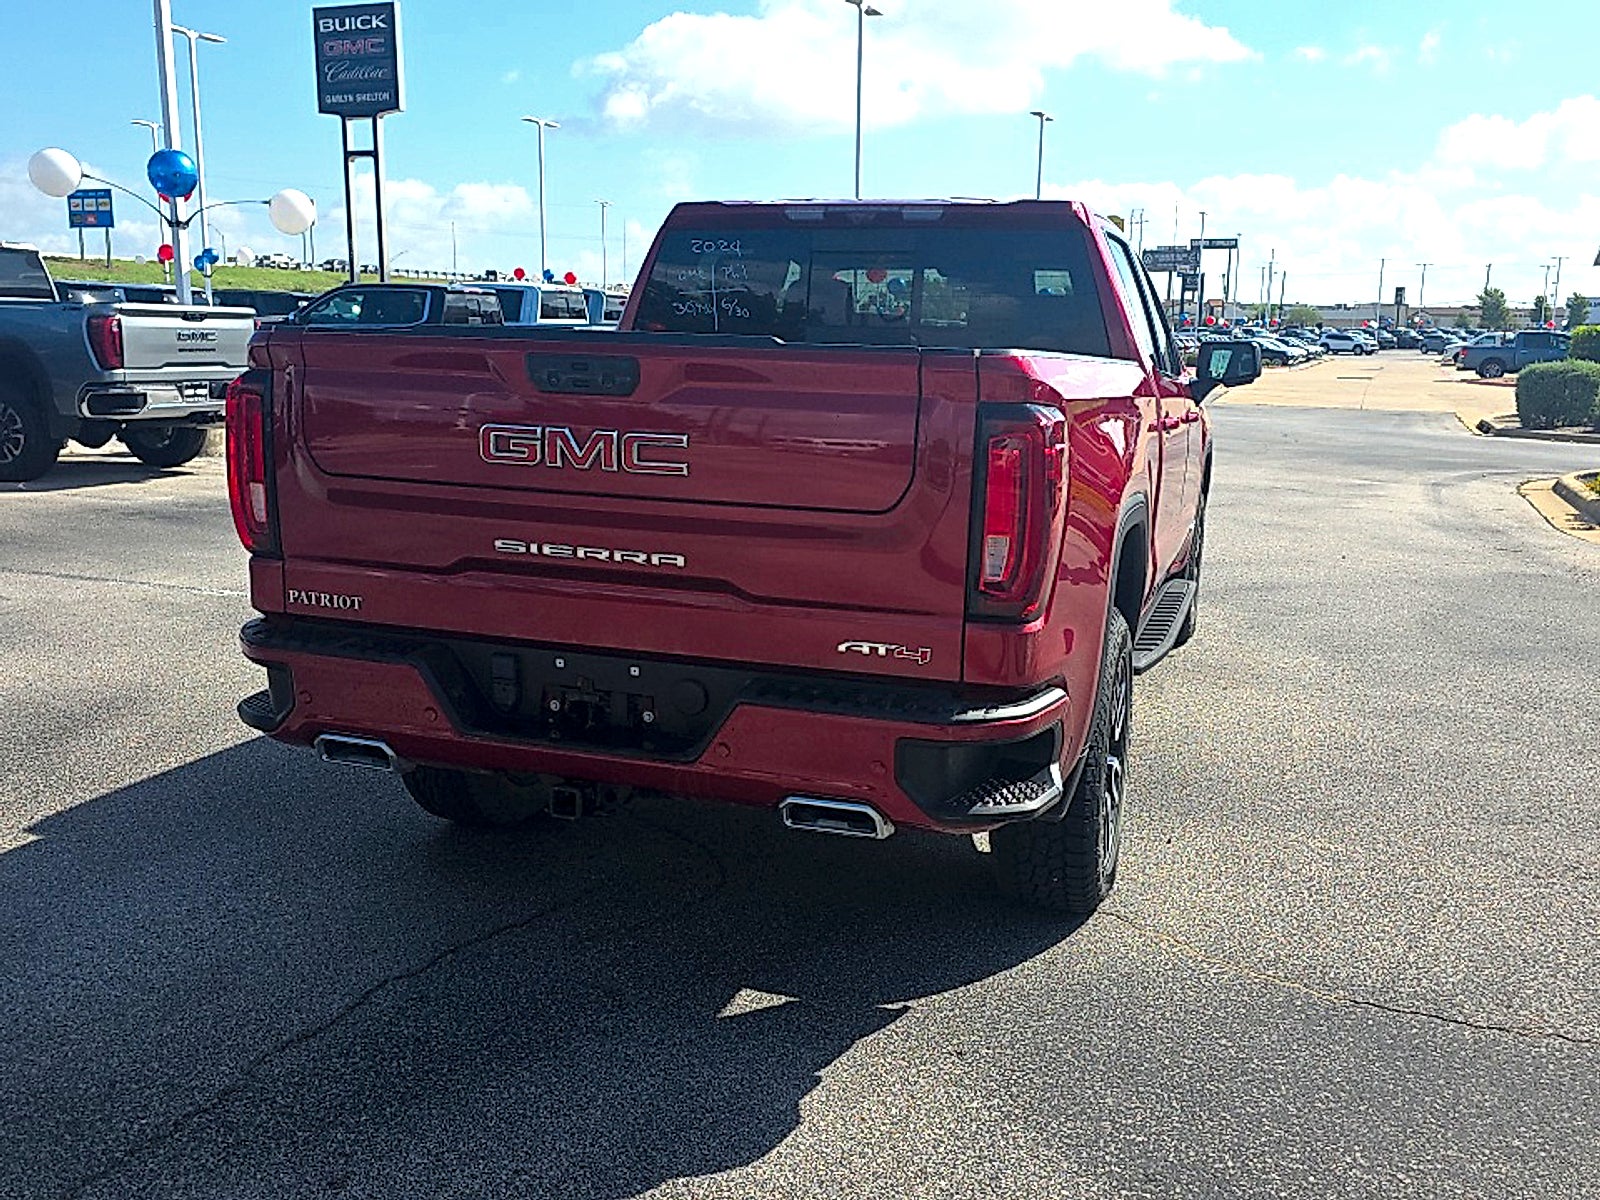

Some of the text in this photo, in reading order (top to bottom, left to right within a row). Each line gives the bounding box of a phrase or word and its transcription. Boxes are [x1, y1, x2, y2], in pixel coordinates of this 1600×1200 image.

[319, 14, 388, 32] BUICK
[323, 38, 385, 56] GMC
[324, 60, 388, 83] Cadillac
[691, 239, 742, 256] 2024
[178, 329, 218, 342] GMC
[479, 423, 689, 477] GMC
[494, 539, 686, 567] SIERRA
[288, 589, 363, 610] PATRIOT
[837, 640, 932, 665] AT4
